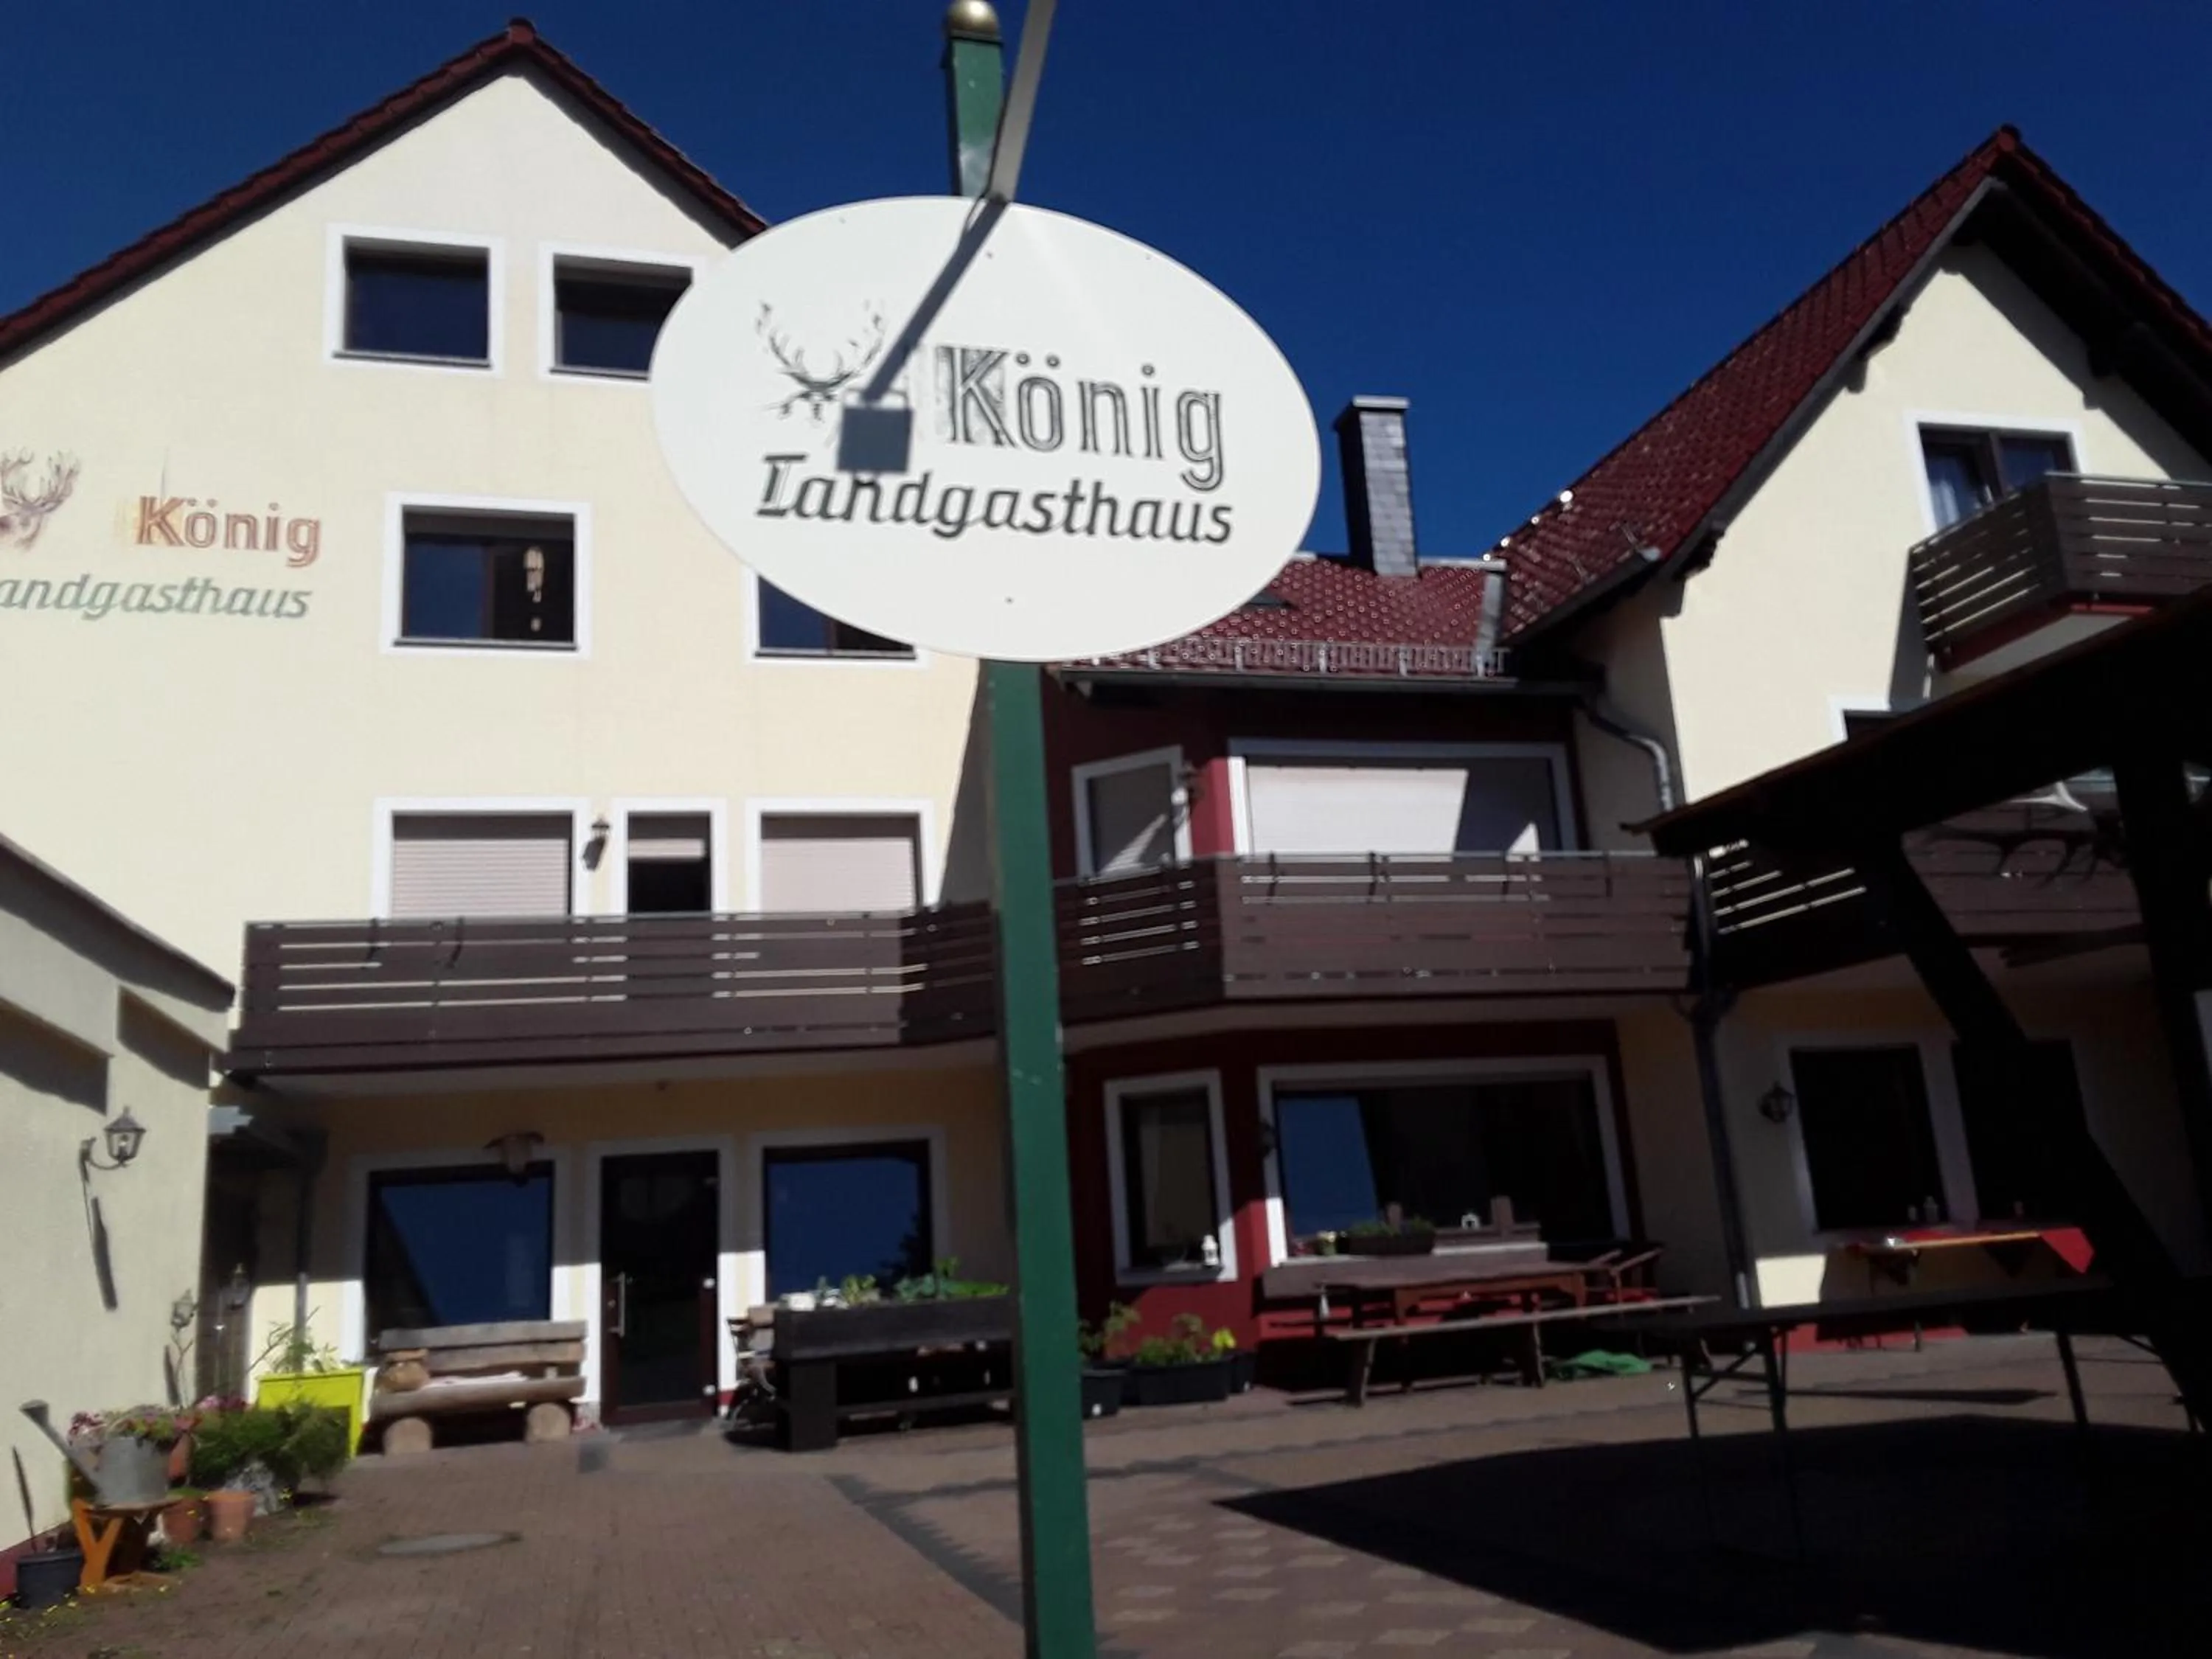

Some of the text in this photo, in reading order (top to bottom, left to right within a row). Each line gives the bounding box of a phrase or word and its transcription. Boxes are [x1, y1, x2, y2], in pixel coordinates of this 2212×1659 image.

[938, 345, 1225, 492] König
[136, 495, 321, 568] König
[757, 453, 1233, 543] Landgasthaus
[0, 573, 313, 620] andgasthaus
